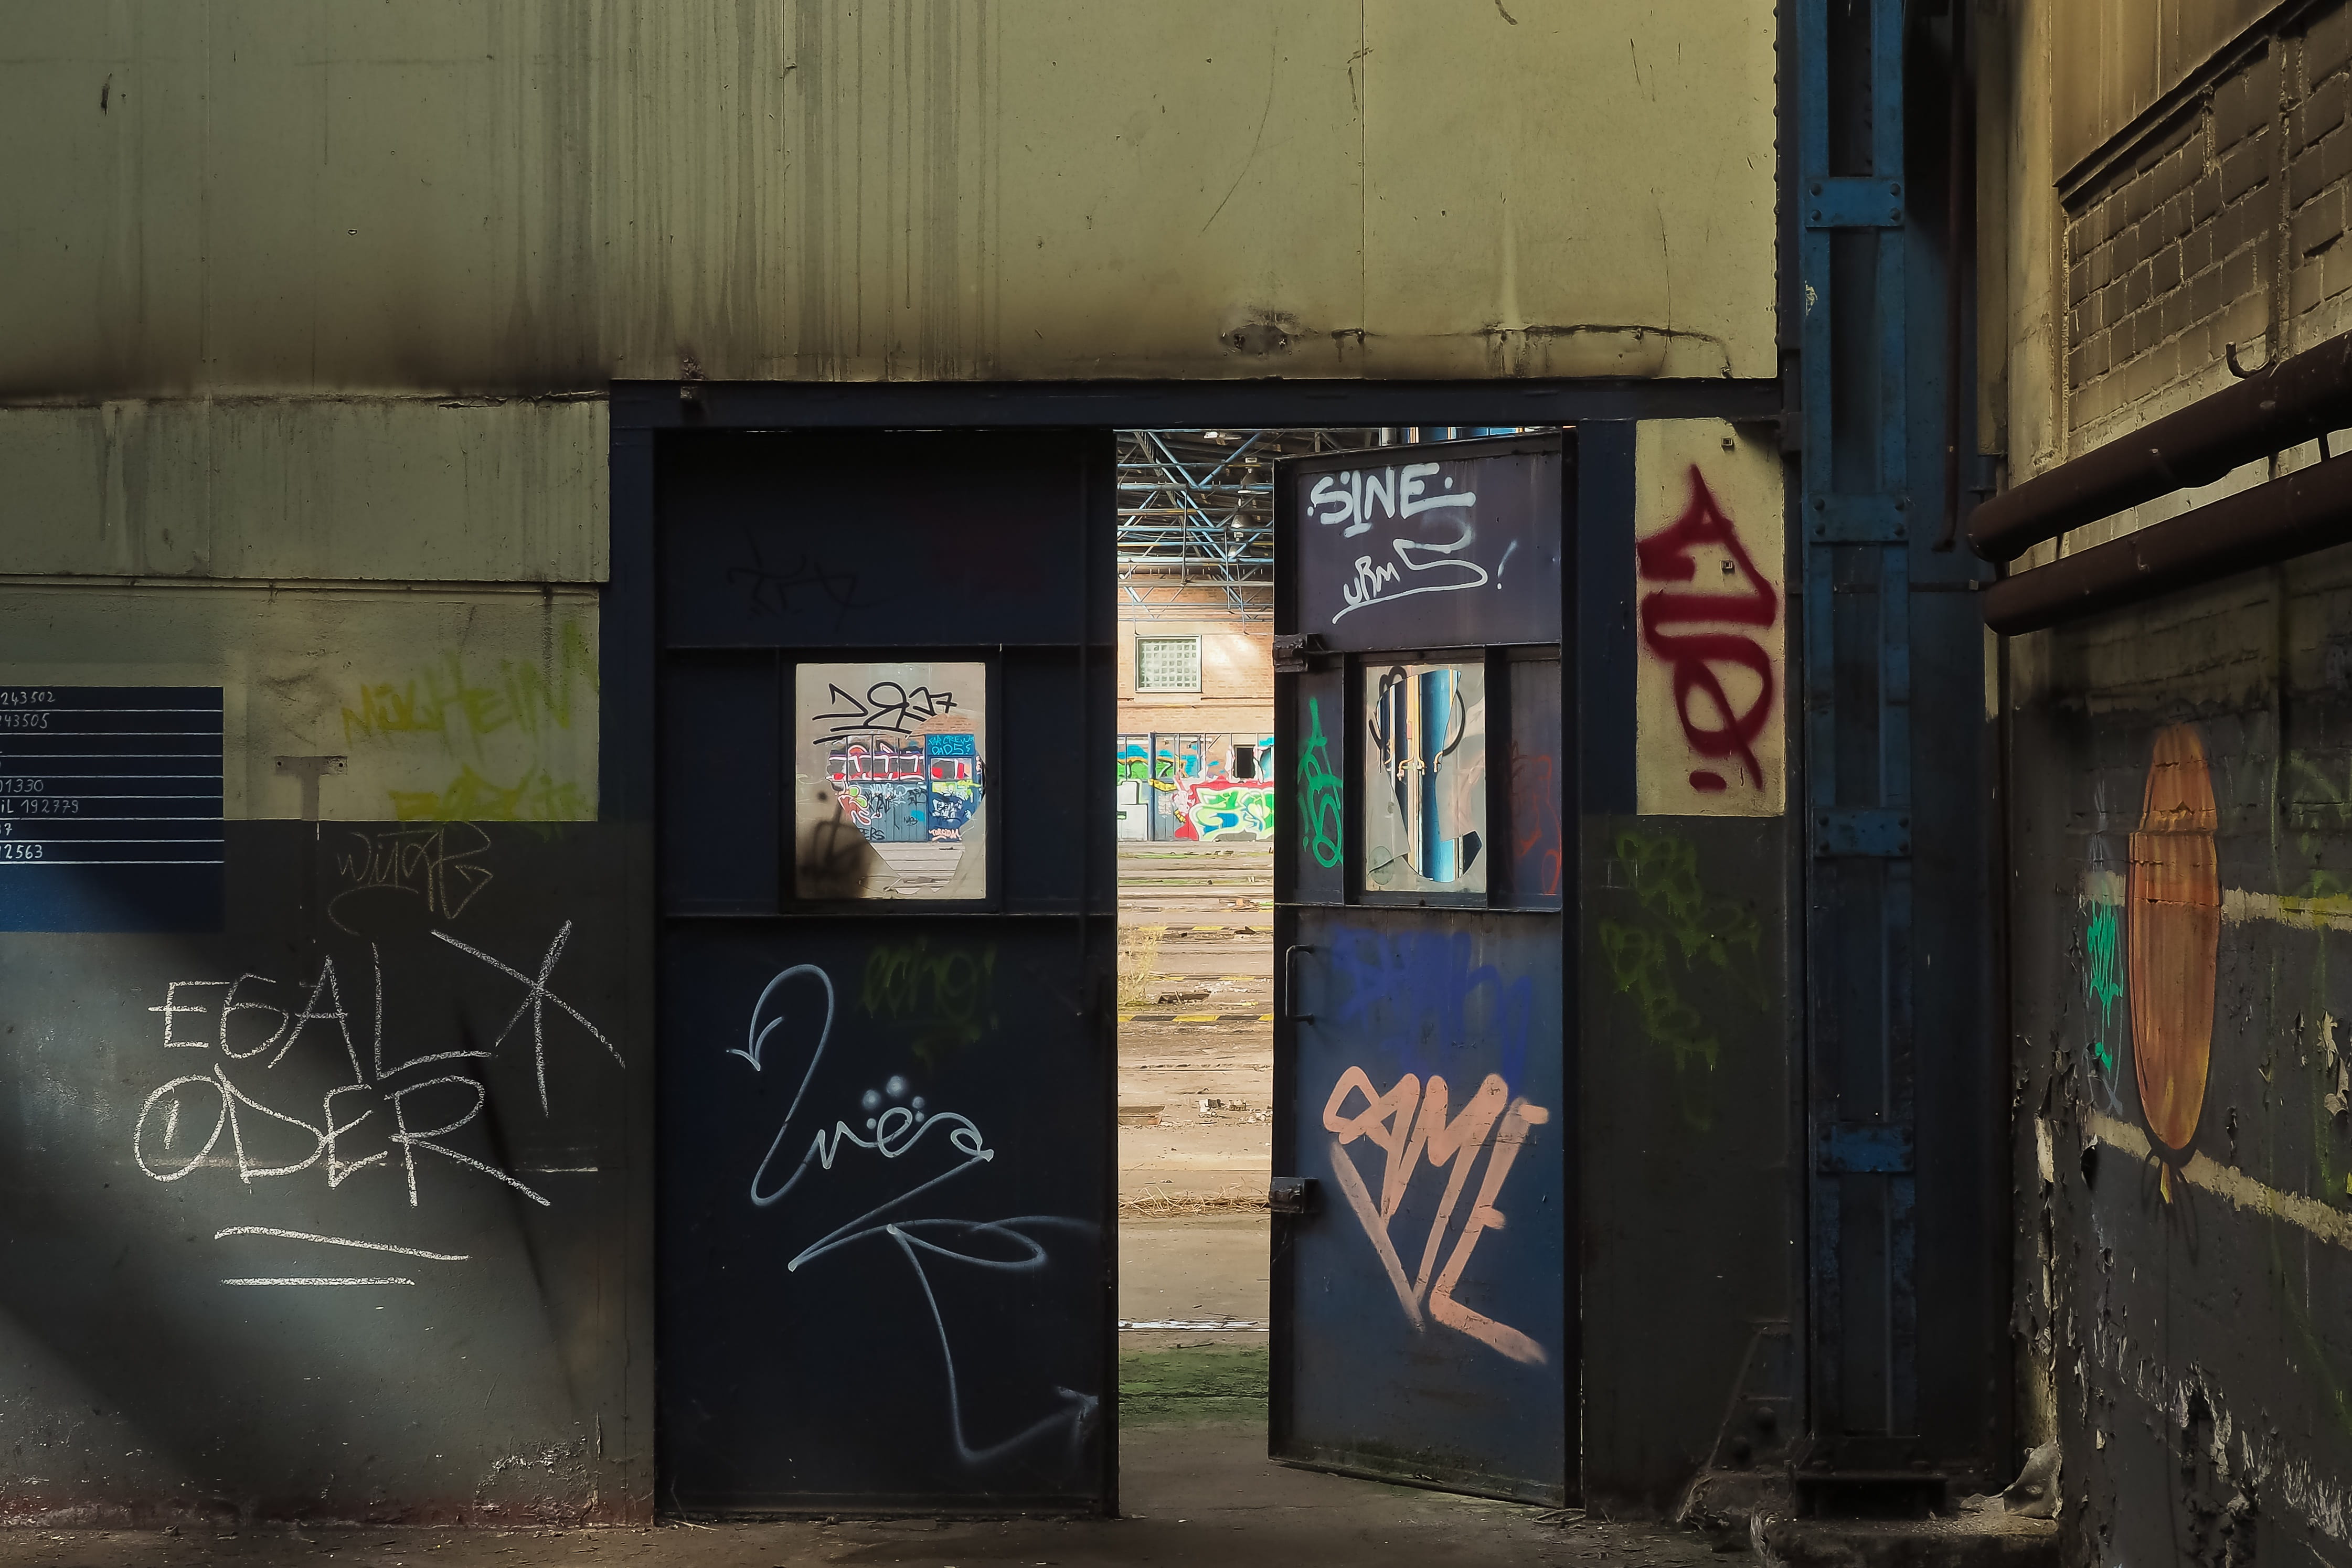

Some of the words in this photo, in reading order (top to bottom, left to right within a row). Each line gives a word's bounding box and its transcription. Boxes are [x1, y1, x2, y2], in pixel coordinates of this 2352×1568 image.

[1, 691, 55, 706] 243502
[0, 713, 50, 729] 43505
[20, 799, 79, 813] 192779
[0, 844, 42, 859] 2563
